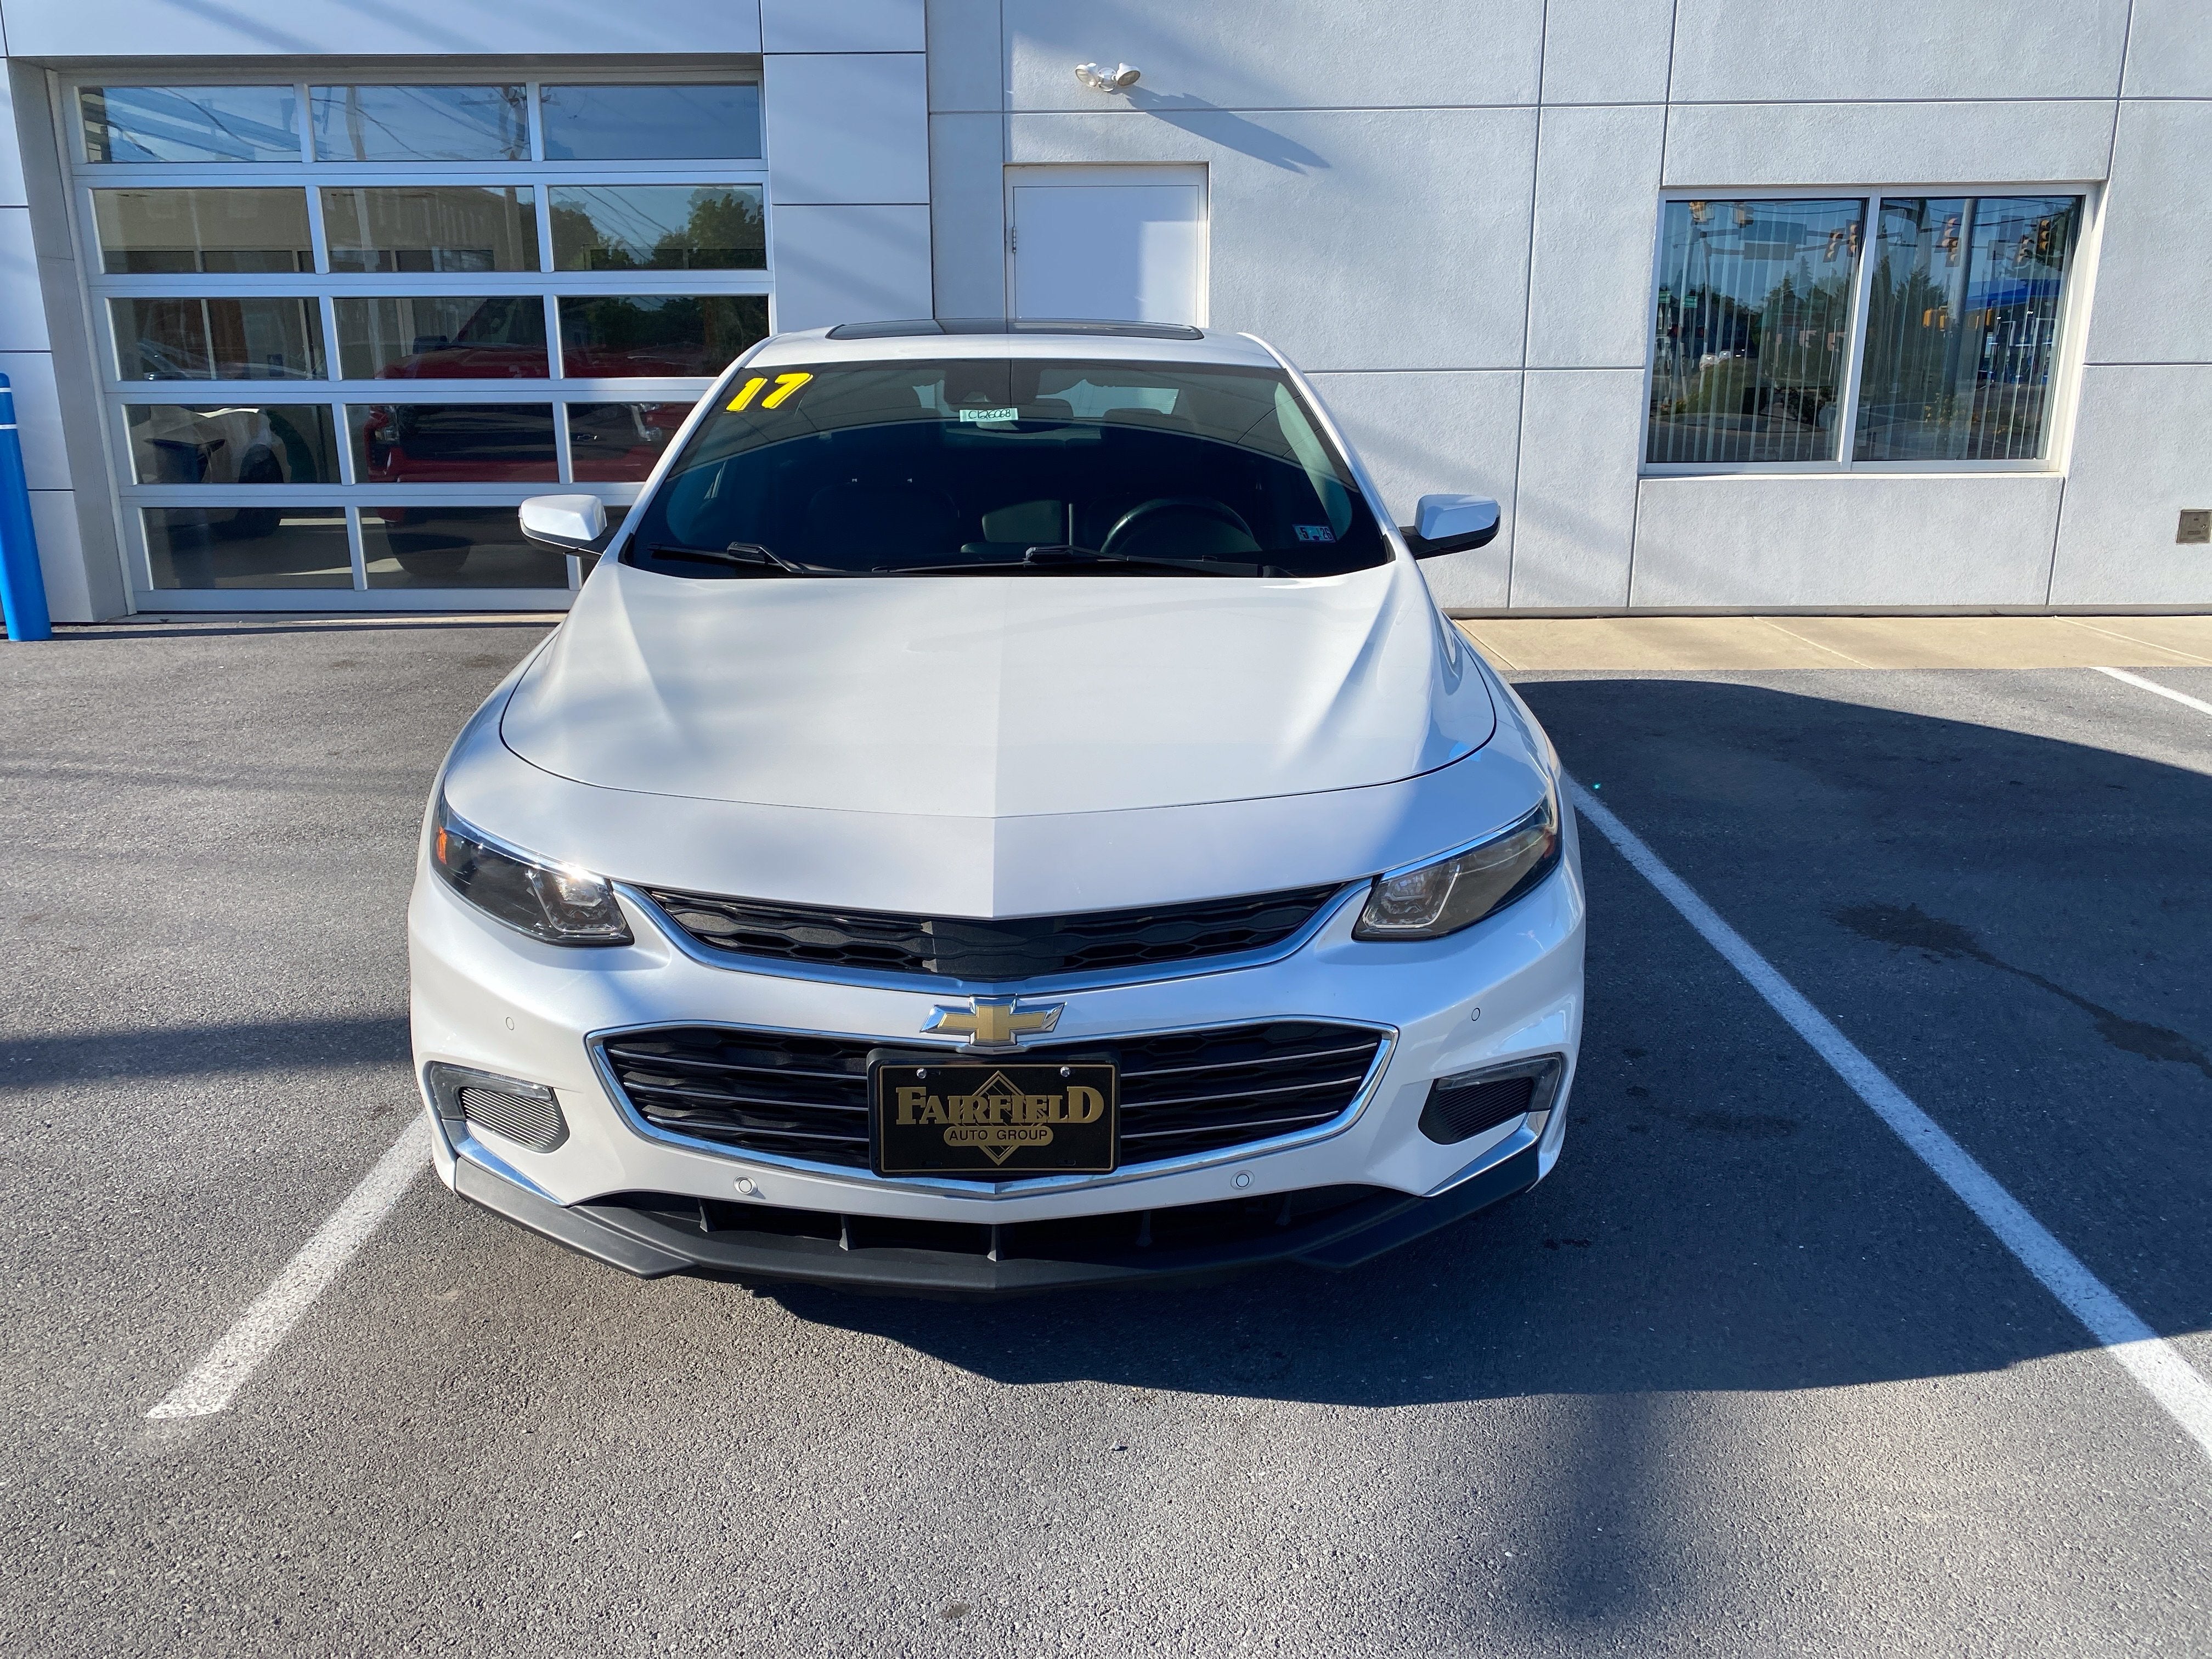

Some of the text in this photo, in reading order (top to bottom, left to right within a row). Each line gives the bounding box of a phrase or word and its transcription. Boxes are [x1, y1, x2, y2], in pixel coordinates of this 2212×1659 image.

[725, 372, 814, 411] 17
[895, 1086, 1104, 1125] FAIRFIELD
[949, 1129, 1048, 1141] AUTO GROUP
